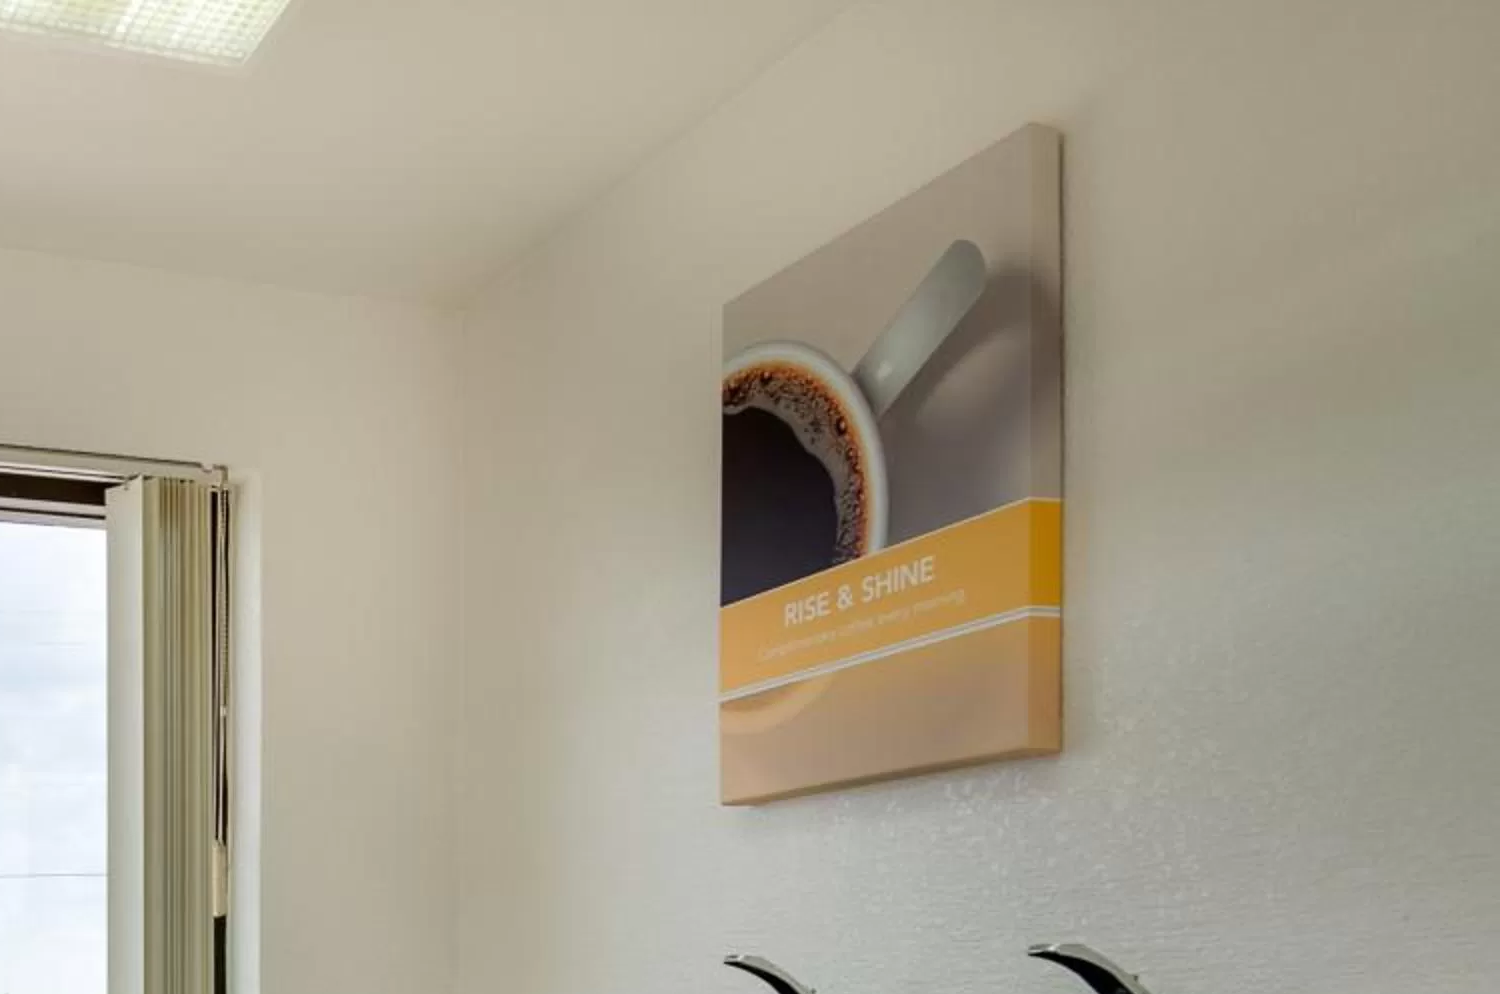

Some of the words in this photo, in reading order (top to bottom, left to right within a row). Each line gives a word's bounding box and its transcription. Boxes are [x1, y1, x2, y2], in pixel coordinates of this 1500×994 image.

[784, 591, 830, 627] RISE
[836, 586, 853, 611] &
[862, 555, 934, 603] SHINE
